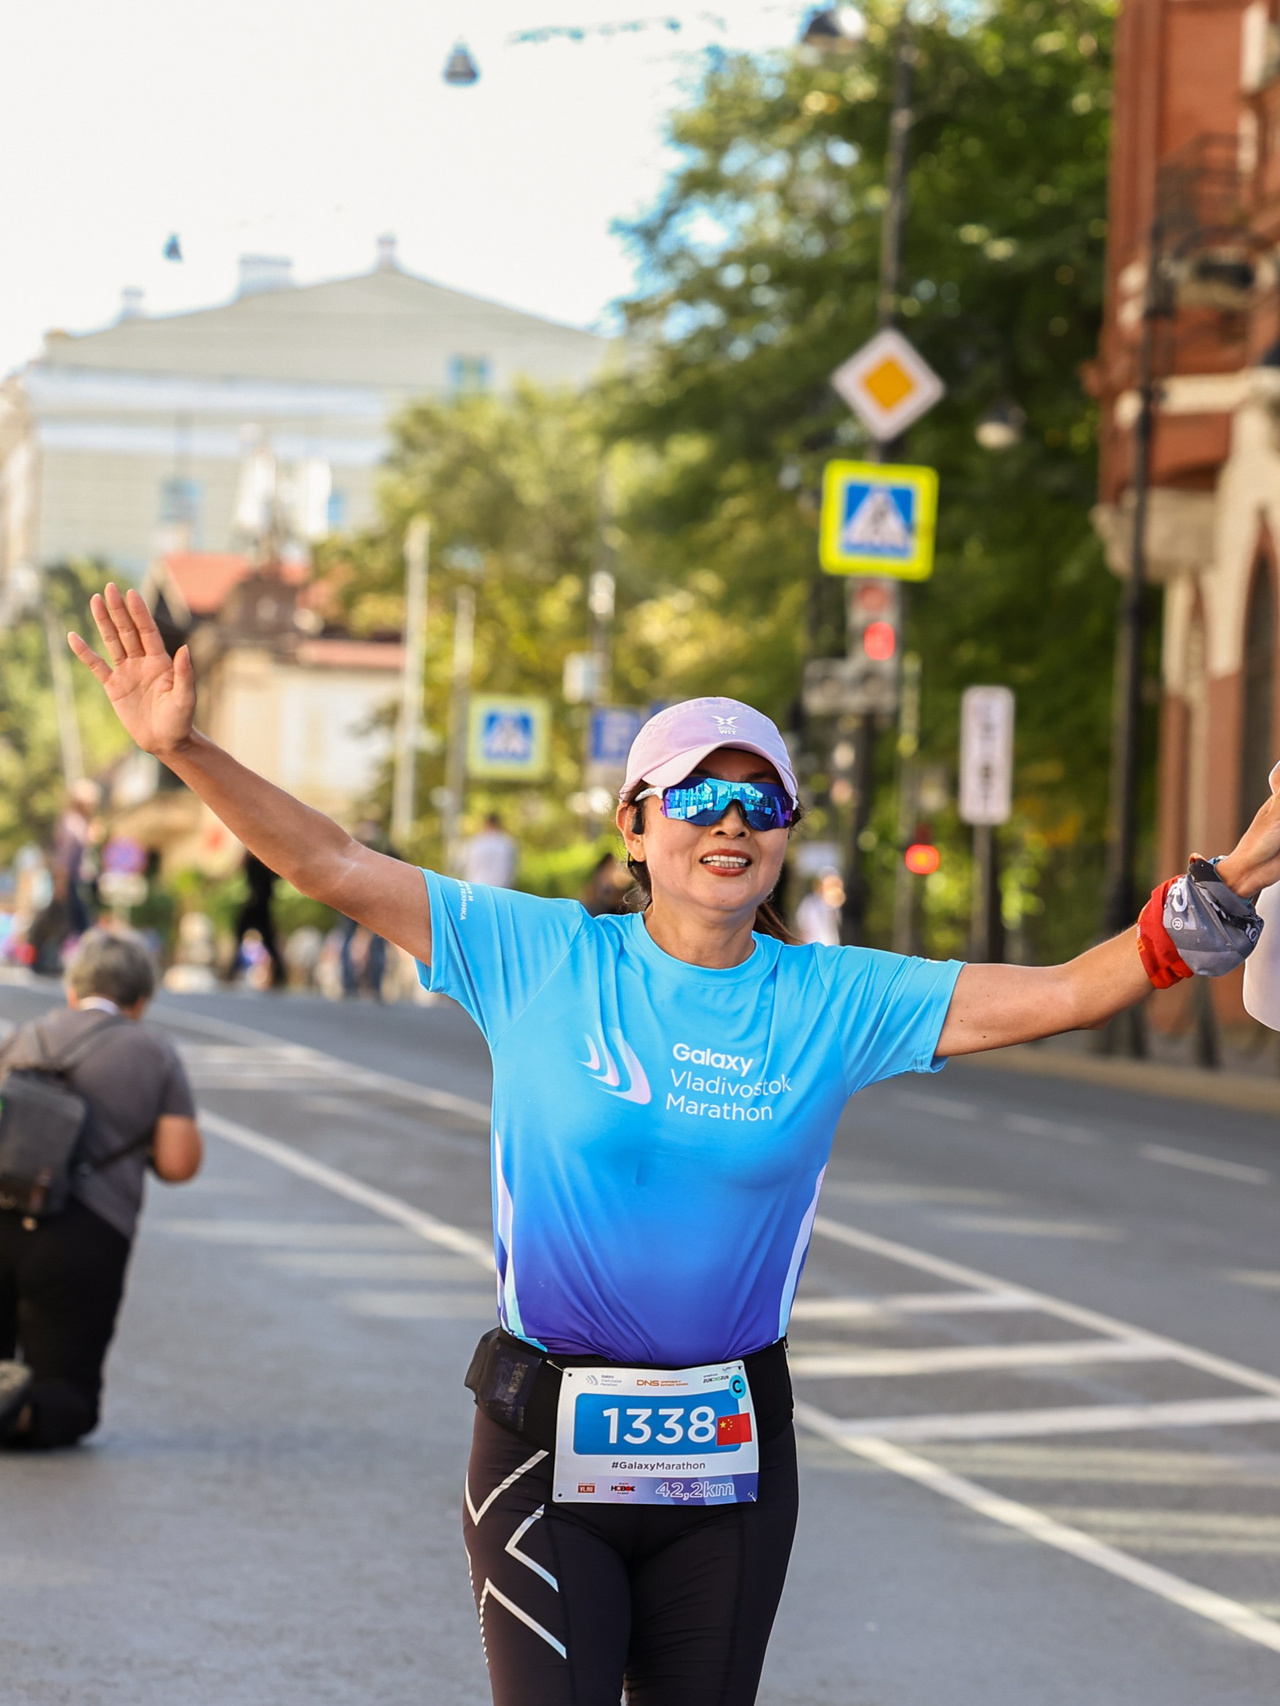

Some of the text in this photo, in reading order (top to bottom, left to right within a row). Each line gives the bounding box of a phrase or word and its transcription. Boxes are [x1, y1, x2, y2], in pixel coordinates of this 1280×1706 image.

[672, 1042, 753, 1077] Galaxy
[669, 1068, 792, 1098] Vladivostok
[666, 1093, 773, 1121] Marathon
[732, 1379, 742, 1393] C
[602, 1405, 716, 1445] 1338
[611, 1461, 706, 1471] #GalaxyMarathon
[655, 1481, 735, 1500] 42,2km
